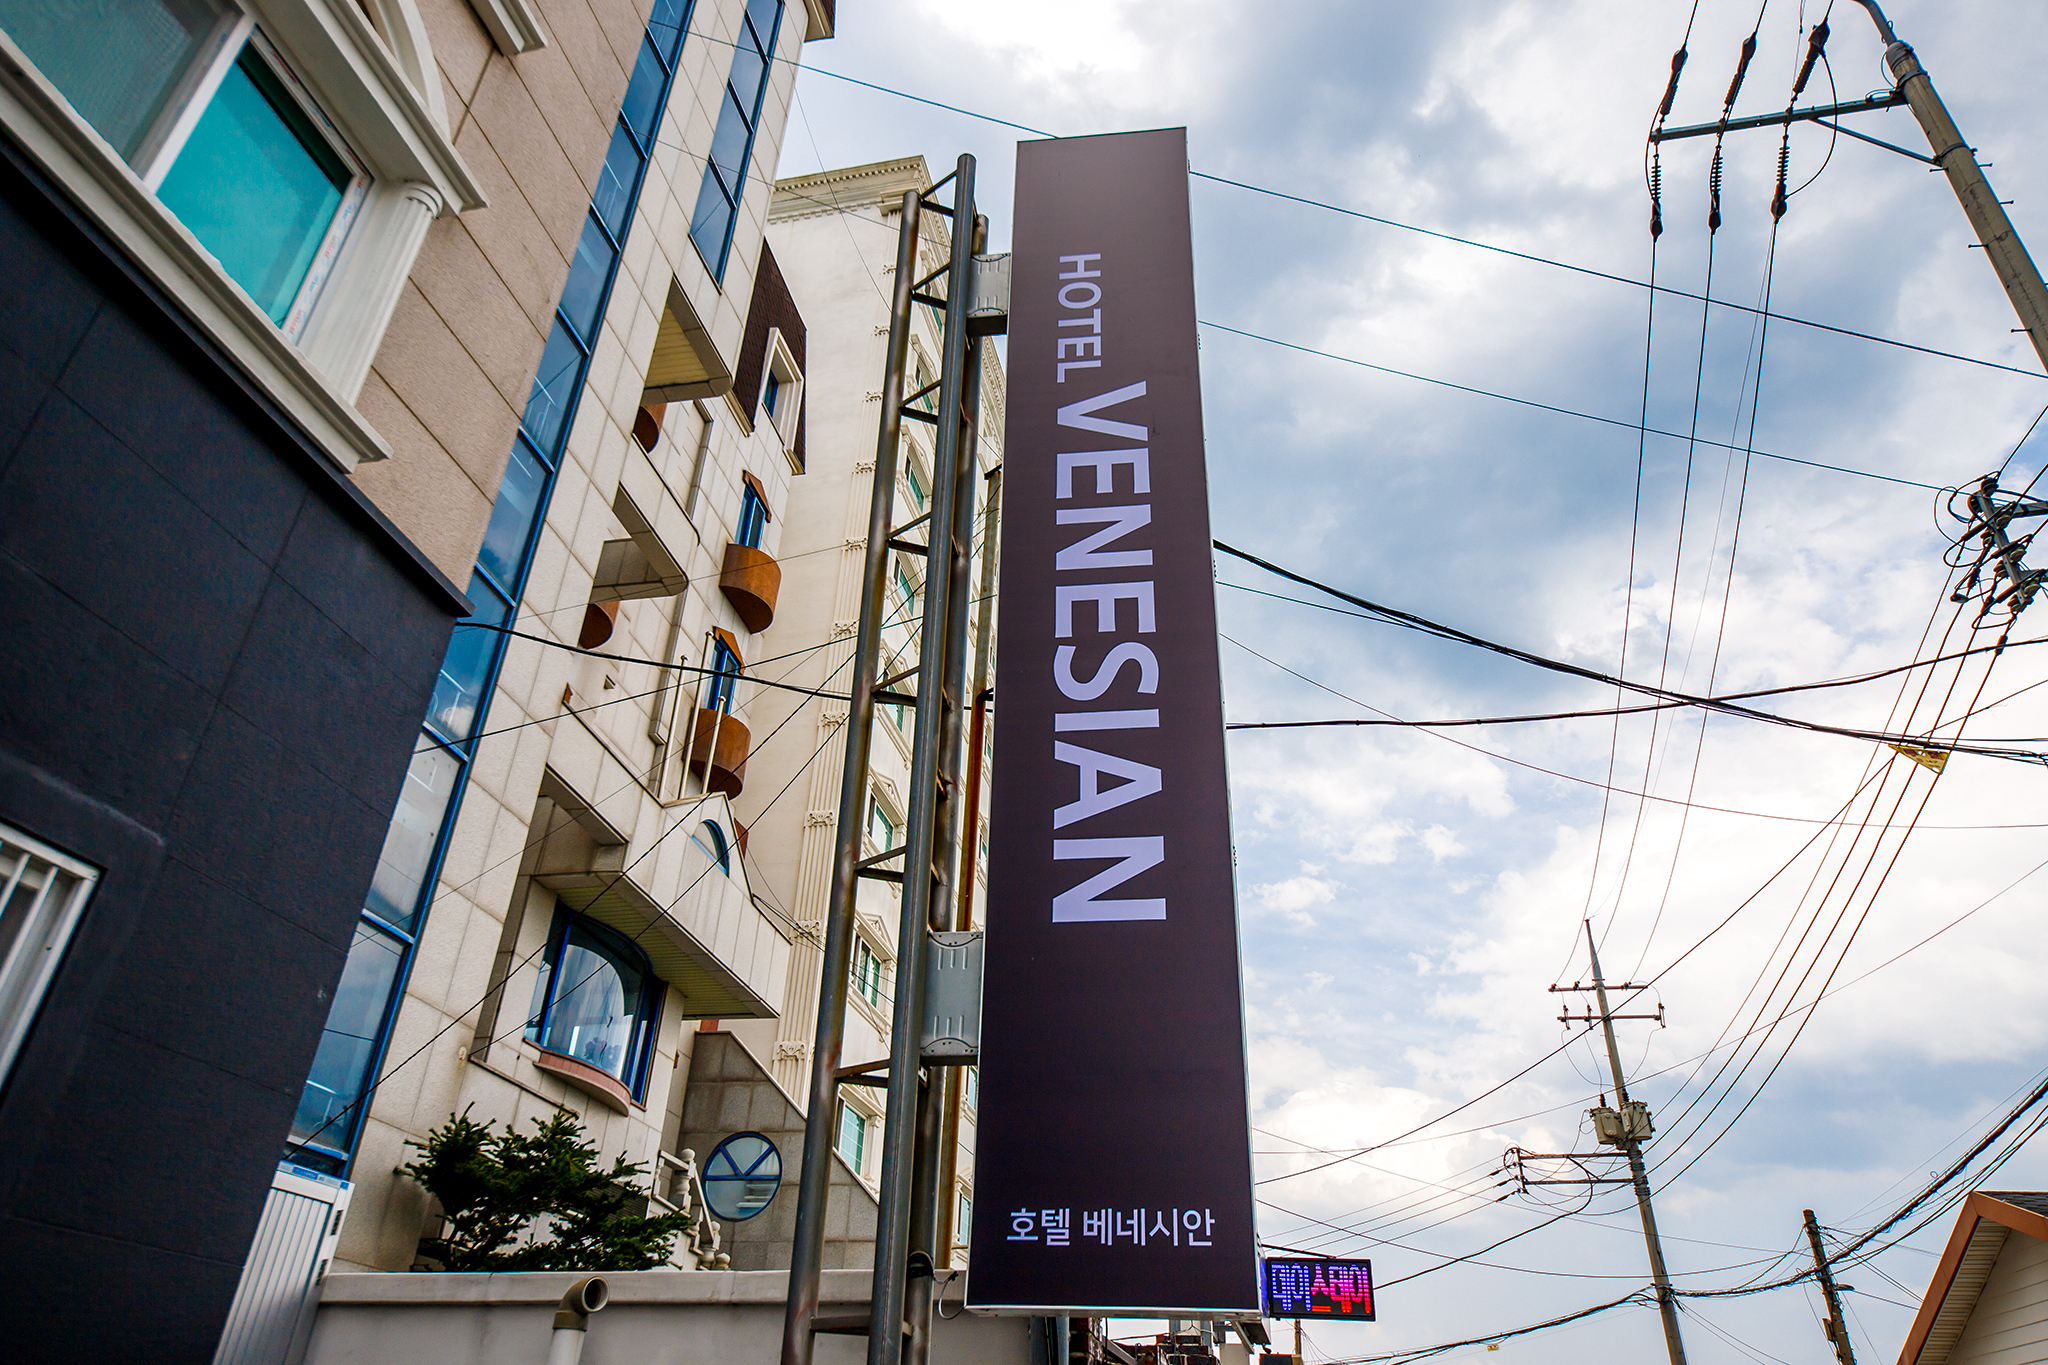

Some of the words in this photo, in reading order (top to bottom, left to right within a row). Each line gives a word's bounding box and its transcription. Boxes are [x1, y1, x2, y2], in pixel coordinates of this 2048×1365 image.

[1057, 252, 1102, 384] HOTEL
[1052, 380, 1167, 923] VENESIAN
[1006, 1207, 1071, 1247] 호텔
[1082, 1207, 1216, 1248] 베네시안
